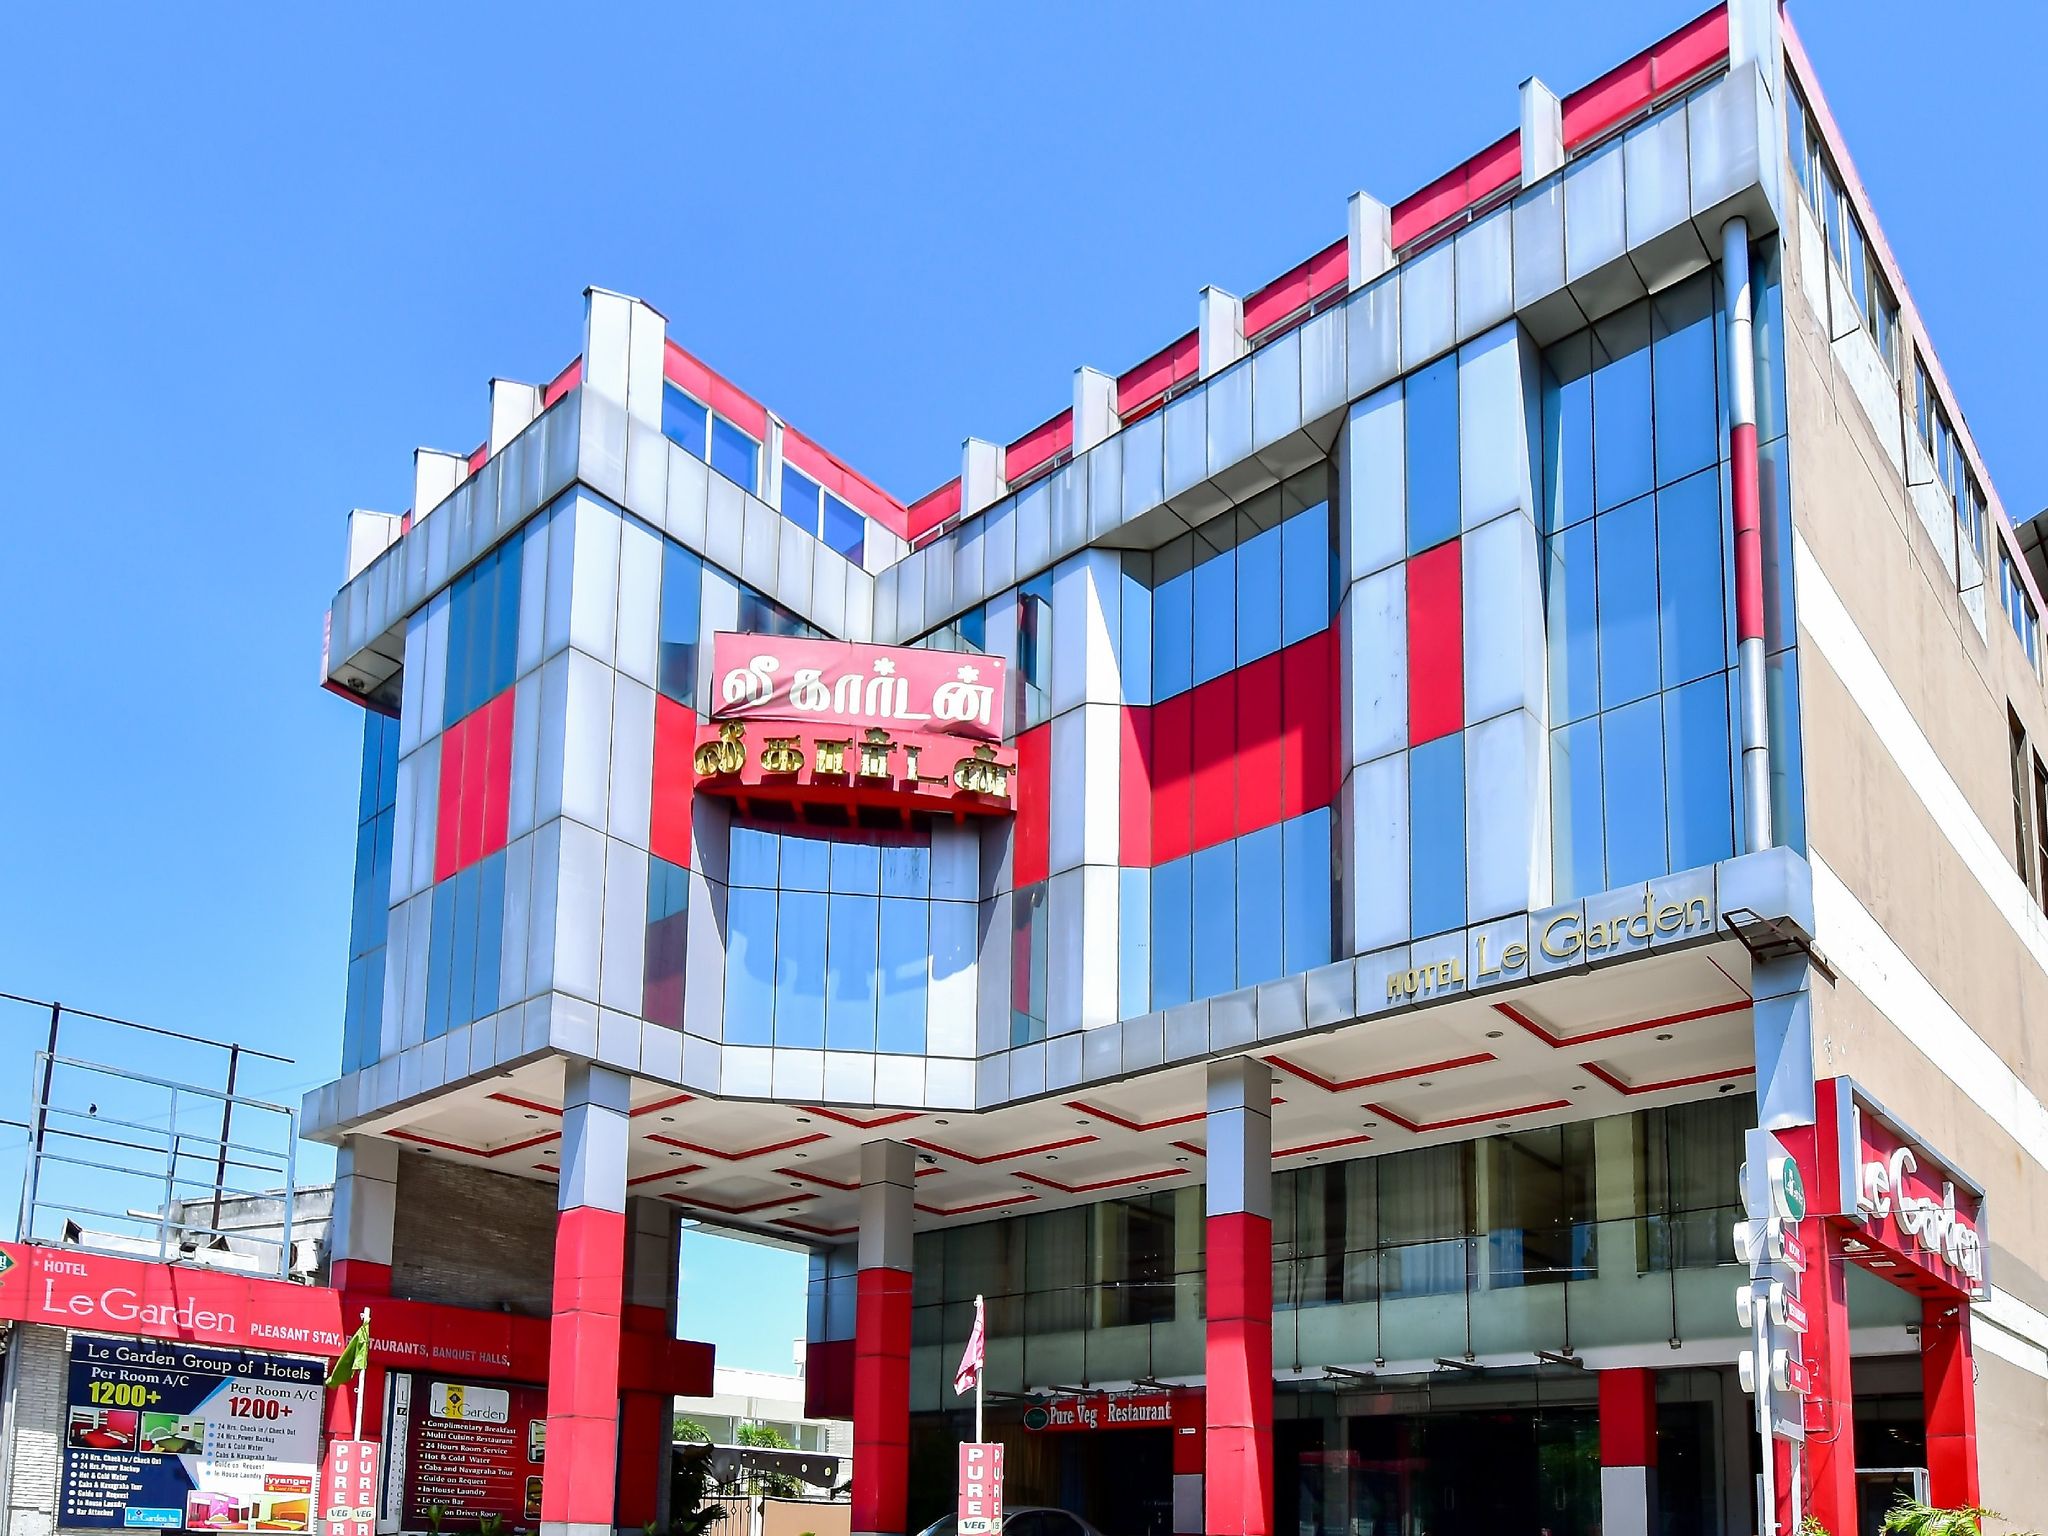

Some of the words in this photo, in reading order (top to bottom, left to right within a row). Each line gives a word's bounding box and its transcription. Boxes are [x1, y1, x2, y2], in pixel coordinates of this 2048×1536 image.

[1386, 958, 1465, 998] HOTEL
[1476, 935, 1528, 976] Le
[1541, 891, 1710, 957] Garden
[1853, 1104, 1891, 1219] Le
[1889, 1146, 1983, 1281] Garden
[43, 1259, 88, 1276] HOTEL
[43, 1278, 95, 1315] Le
[100, 1288, 235, 1333] Garden
[250, 1323, 310, 1342] PLEASANT
[312, 1330, 342, 1347] STAY,
[432, 1346, 476, 1363] BANQUET
[479, 1351, 511, 1367] HALLS,
[88, 1344, 109, 1359] Le
[116, 1346, 176, 1366] Garden
[182, 1354, 231, 1374] Group
[238, 1359, 254, 1374] of
[264, 1362, 311, 1380] Hotels
[91, 1367, 116, 1379] Per
[119, 1370, 159, 1384] Room
[162, 1375, 190, 1387] A/C
[88, 1381, 162, 1407] 1200+
[230, 1383, 252, 1394] Per
[255, 1385, 291, 1398] Room
[293, 1389, 318, 1402] A/C
[229, 1396, 293, 1421] 1200+
[433, 1400, 450, 1415] Le
[457, 1404, 506, 1420] Garden
[1050, 1406, 1074, 1424] Pure
[1077, 1404, 1098, 1428] Veg
[1107, 1401, 1172, 1422] Restaurant
[427, 1420, 482, 1432] Complimentary
[484, 1426, 516, 1434] Breakfast
[448, 1433, 474, 1441] Cuisine
[476, 1435, 513, 1444] Restaurant
[424, 1452, 438, 1460] Hot
[448, 1454, 465, 1462] Cold
[469, 1456, 491, 1464] Water
[437, 1443, 458, 1451] Hours
[460, 1445, 481, 1453] Room
[483, 1446, 508, 1455] Service
[334, 1444, 349, 1505] PURE
[359, 1445, 373, 1505] PURE
[458, 1476, 486, 1485] Request
[459, 1466, 496, 1475] Navagraha
[498, 1468, 513, 1476] Tour
[422, 1485, 455, 1494] In-House
[457, 1487, 486, 1496] Laundry
[967, 1448, 984, 1515] PURE
[331, 1509, 348, 1517] VEG
[964, 1521, 986, 1529] VEG
